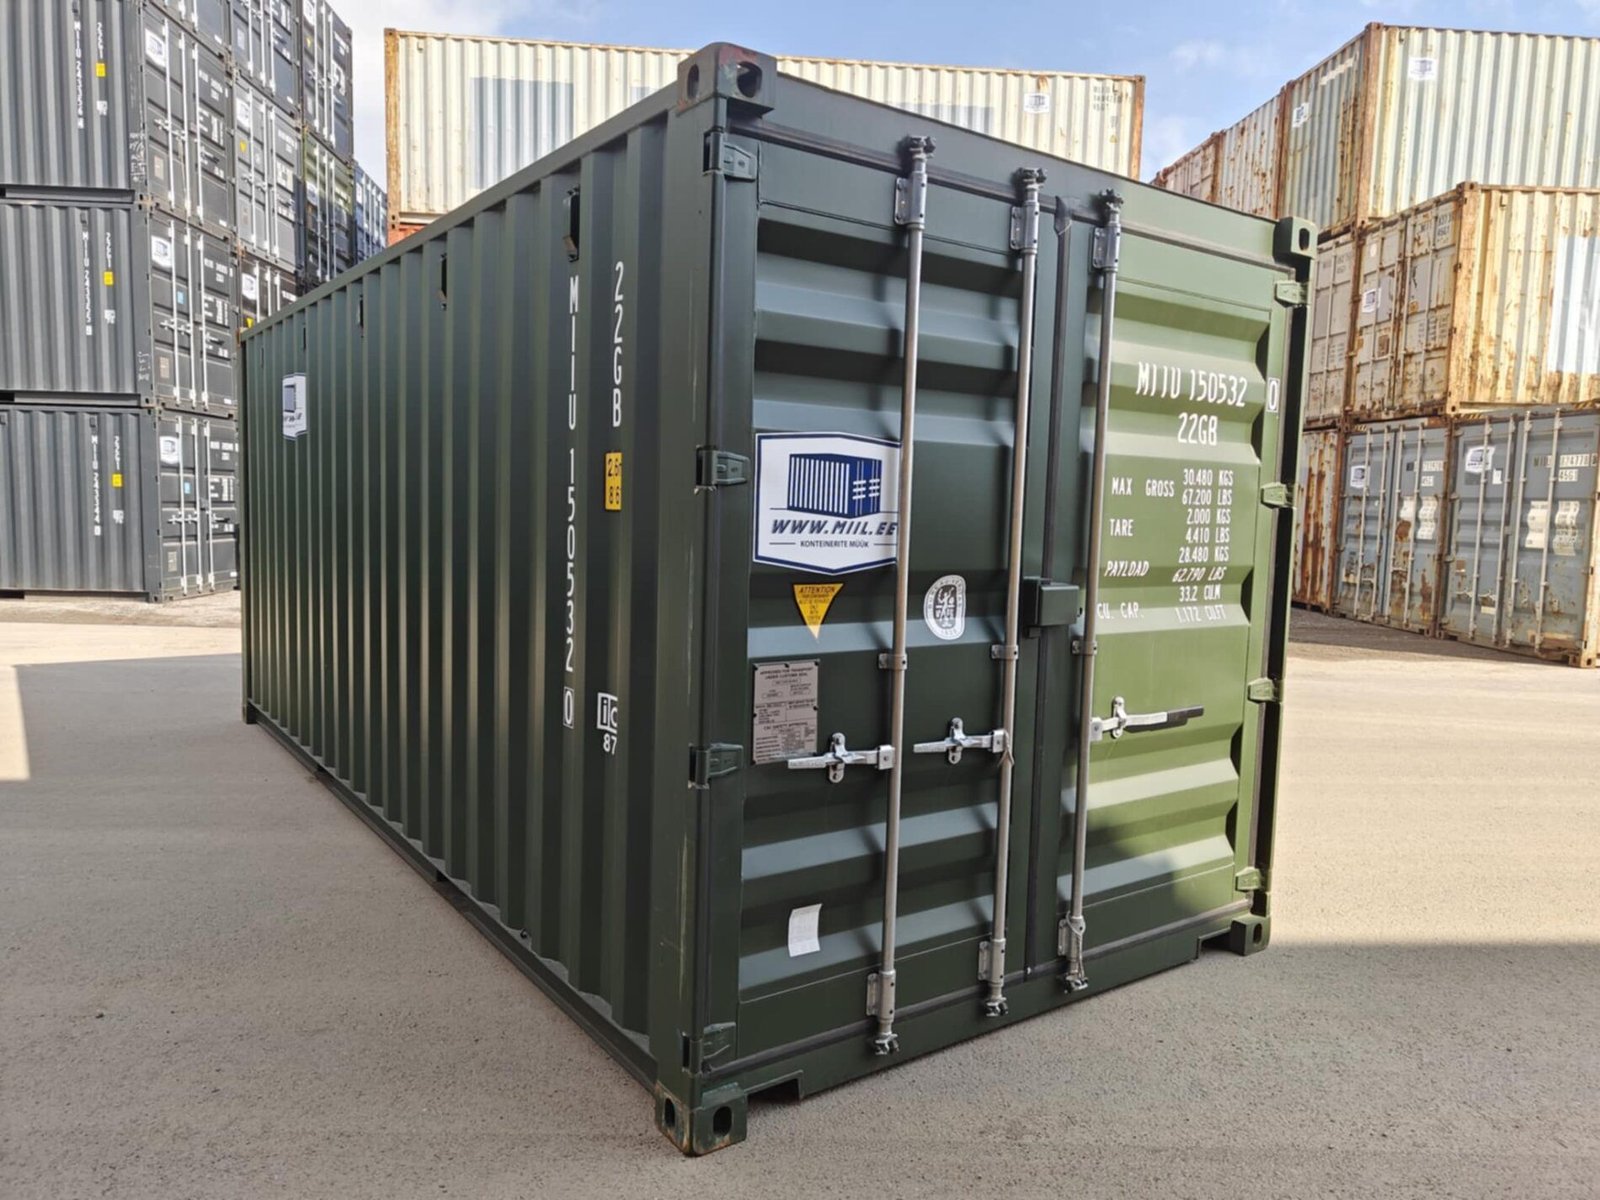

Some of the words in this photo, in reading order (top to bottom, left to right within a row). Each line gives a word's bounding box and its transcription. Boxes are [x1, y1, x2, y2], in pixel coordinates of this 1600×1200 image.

[569, 275, 579, 430] MIIU
[613, 260, 625, 428] 22GB
[1136, 361, 1181, 399] MIIU
[1189, 369, 1248, 407] 150532
[1268, 379, 1278, 411] 0
[1178, 412, 1218, 446] 22GB
[1112, 477, 1133, 495] MAX
[1145, 479, 1175, 497] GROSS
[1183, 468, 1213, 486] 30.480
[1218, 469, 1234, 486] KGS
[1182, 488, 1212, 505] 67.200
[1217, 488, 1232, 505] LBS
[771, 519, 898, 535] WWW.MIIL.EE
[1109, 518, 1134, 536] TARE
[1186, 508, 1211, 525] 2.000
[1216, 508, 1231, 524] KGS
[1185, 527, 1210, 543] 4.410
[1215, 527, 1230, 543] LBS
[565, 447, 576, 673] 150532
[1104, 560, 1150, 577] PAYLOAD
[1178, 546, 1208, 563] 28.480
[1214, 546, 1229, 562] KGS
[1208, 567, 1227, 582] LBS
[1179, 586, 1198, 602] 33.2
[1096, 603, 1114, 620] CU.
[1120, 602, 1144, 619] CAP.
[564, 687, 574, 727] 0
[603, 732, 618, 756] 87
